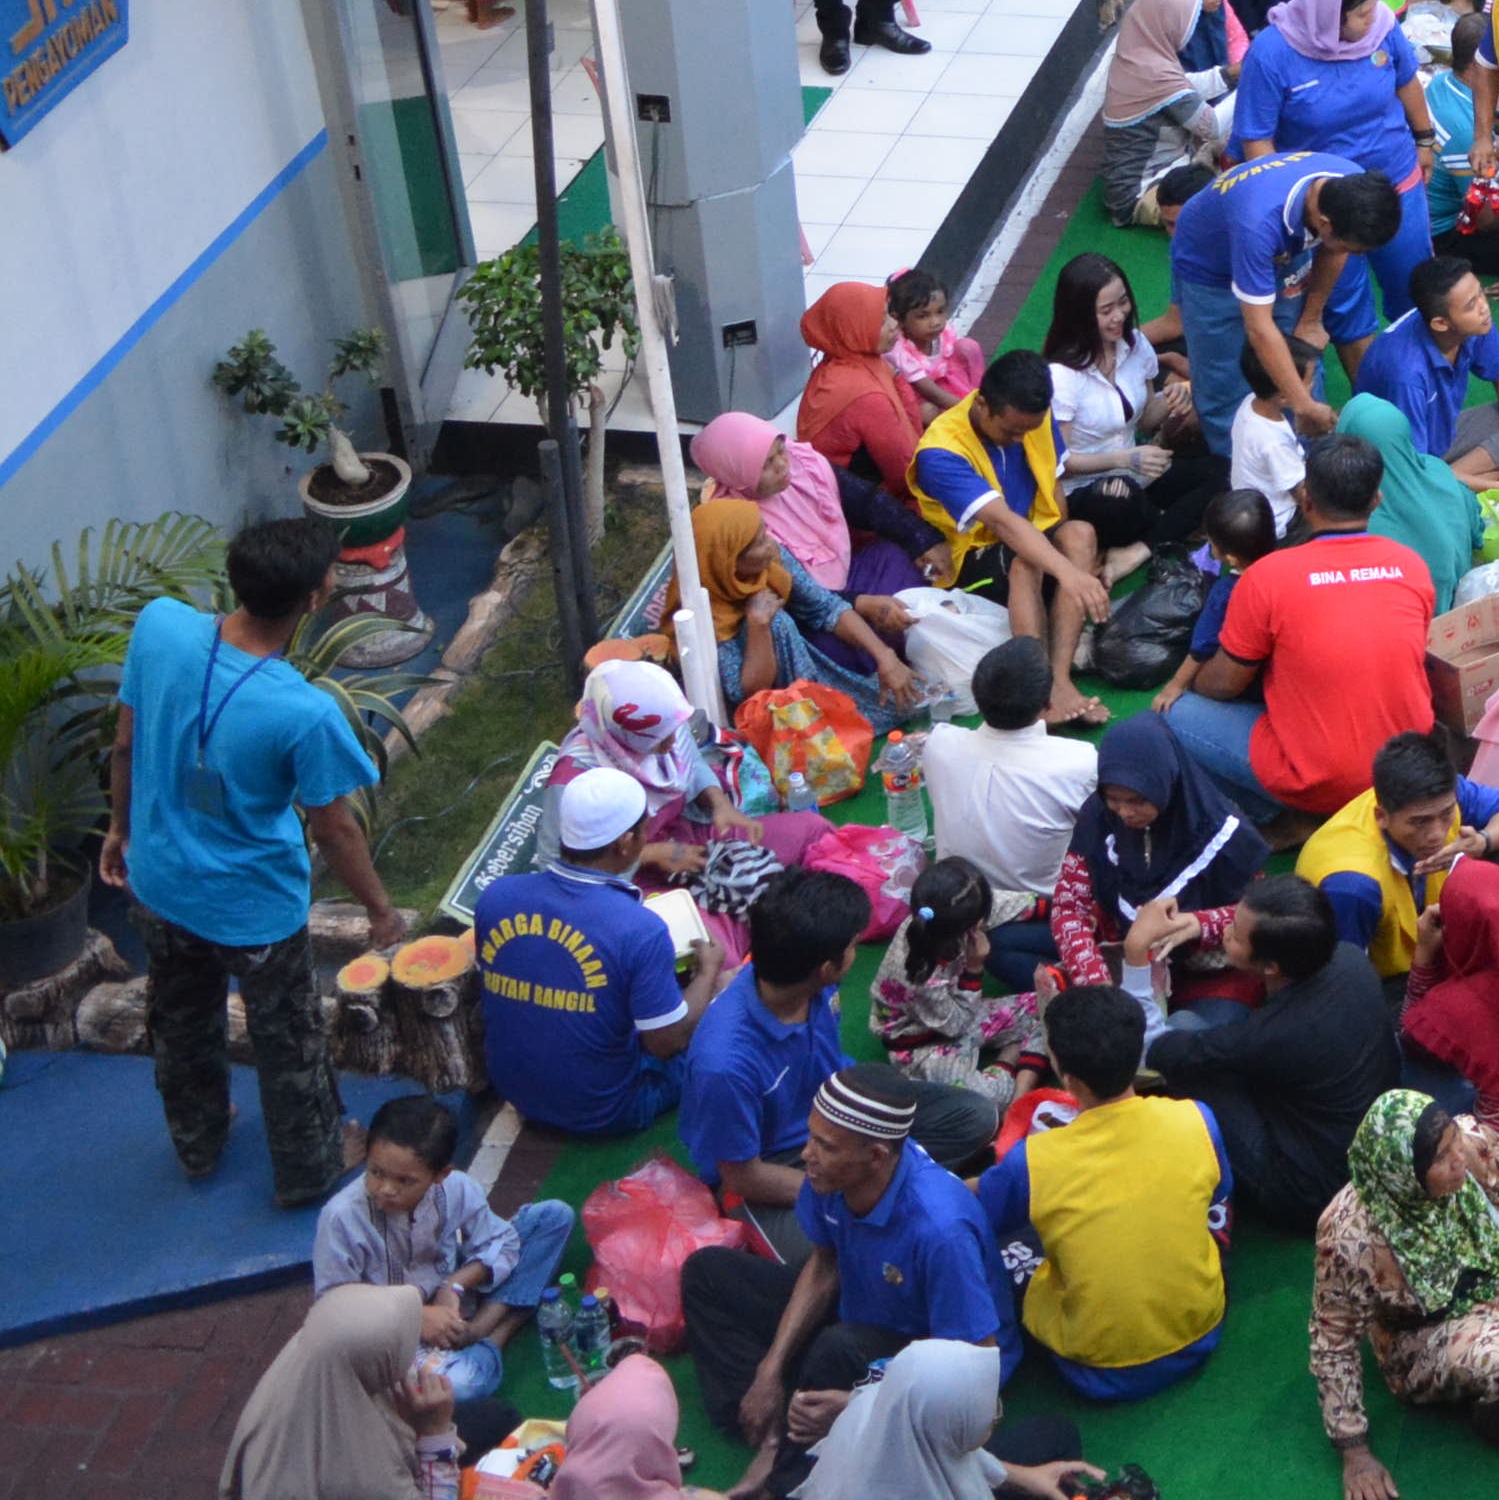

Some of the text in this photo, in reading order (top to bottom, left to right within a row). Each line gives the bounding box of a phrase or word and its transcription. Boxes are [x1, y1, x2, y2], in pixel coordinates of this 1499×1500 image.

[1309, 566, 1404, 586] BINA REMAJA
[481, 914, 608, 989] WARGA BINAAN
[534, 985, 596, 1013] BANGIL
